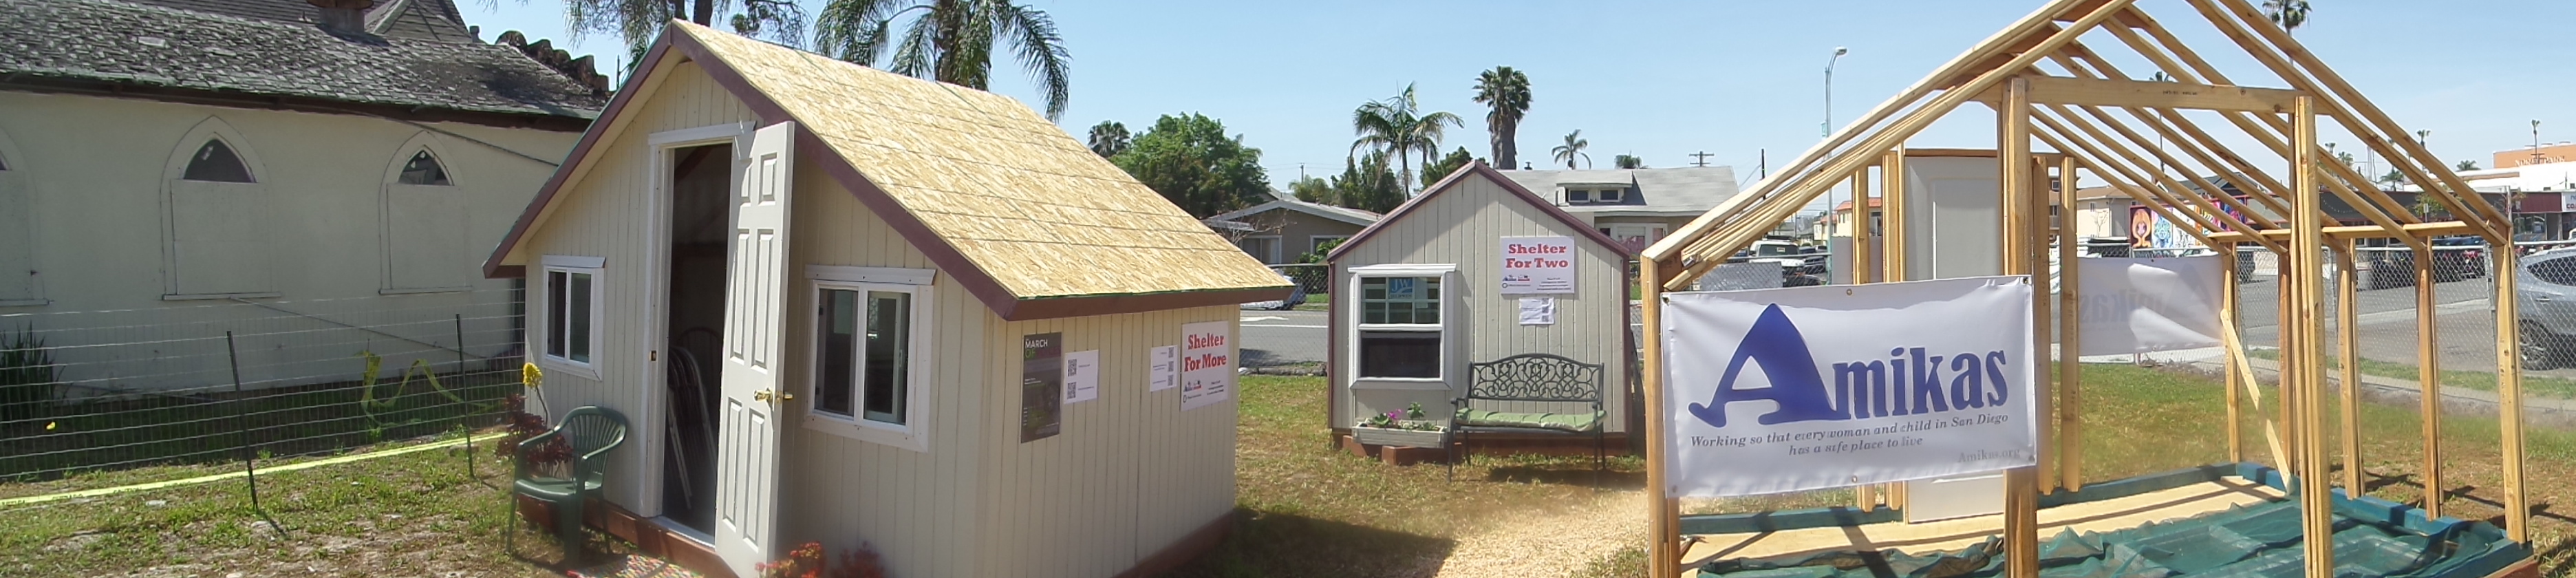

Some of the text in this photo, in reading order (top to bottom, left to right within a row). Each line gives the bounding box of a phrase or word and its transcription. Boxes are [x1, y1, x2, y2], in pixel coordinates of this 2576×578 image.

[1508, 243, 1567, 254] Shelter
[1505, 257, 1569, 268] For Two
[1025, 339, 1048, 348] MARCH
[1188, 332, 1225, 350] Shelter
[1184, 356, 1201, 372] For
[1201, 353, 1227, 370] More
[1688, 303, 2008, 428] Amikas
[1690, 414, 2008, 448] Working so that every woman and child in San Diego
[1789, 445, 1810, 456] has
[1814, 445, 1822, 453] a
[1850, 438, 1884, 453] place
[1887, 437, 1899, 447] to
[1901, 436, 1924, 446] live
